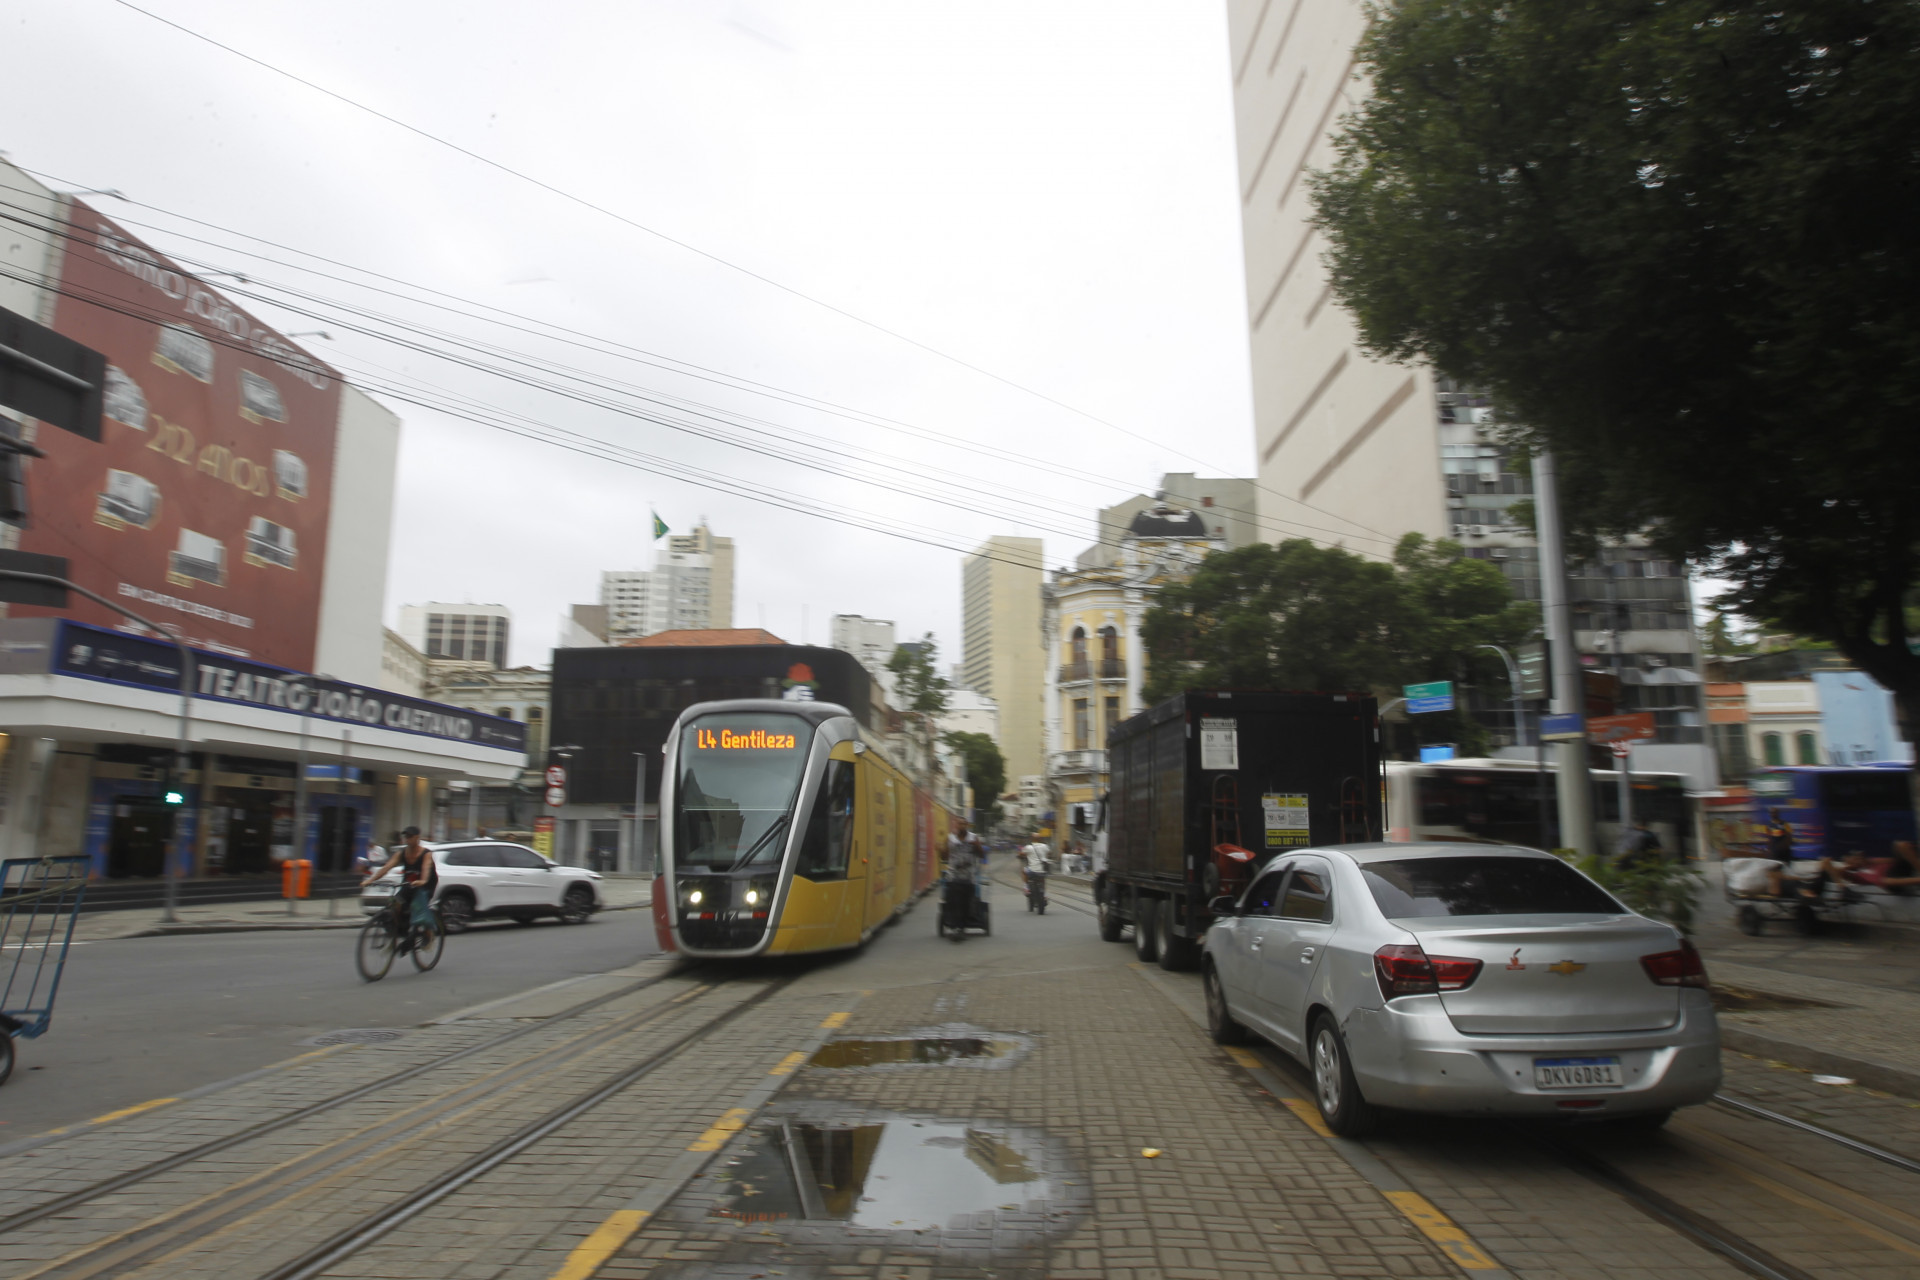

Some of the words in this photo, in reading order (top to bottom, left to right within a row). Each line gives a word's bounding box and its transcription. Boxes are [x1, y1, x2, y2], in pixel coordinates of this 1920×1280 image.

[198, 664, 310, 711] TEATRO
[312, 688, 383, 725] JOÃO
[384, 703, 473, 740] CAETANO
[697, 729, 717, 749] L4
[720, 729, 796, 749] Gentileza
